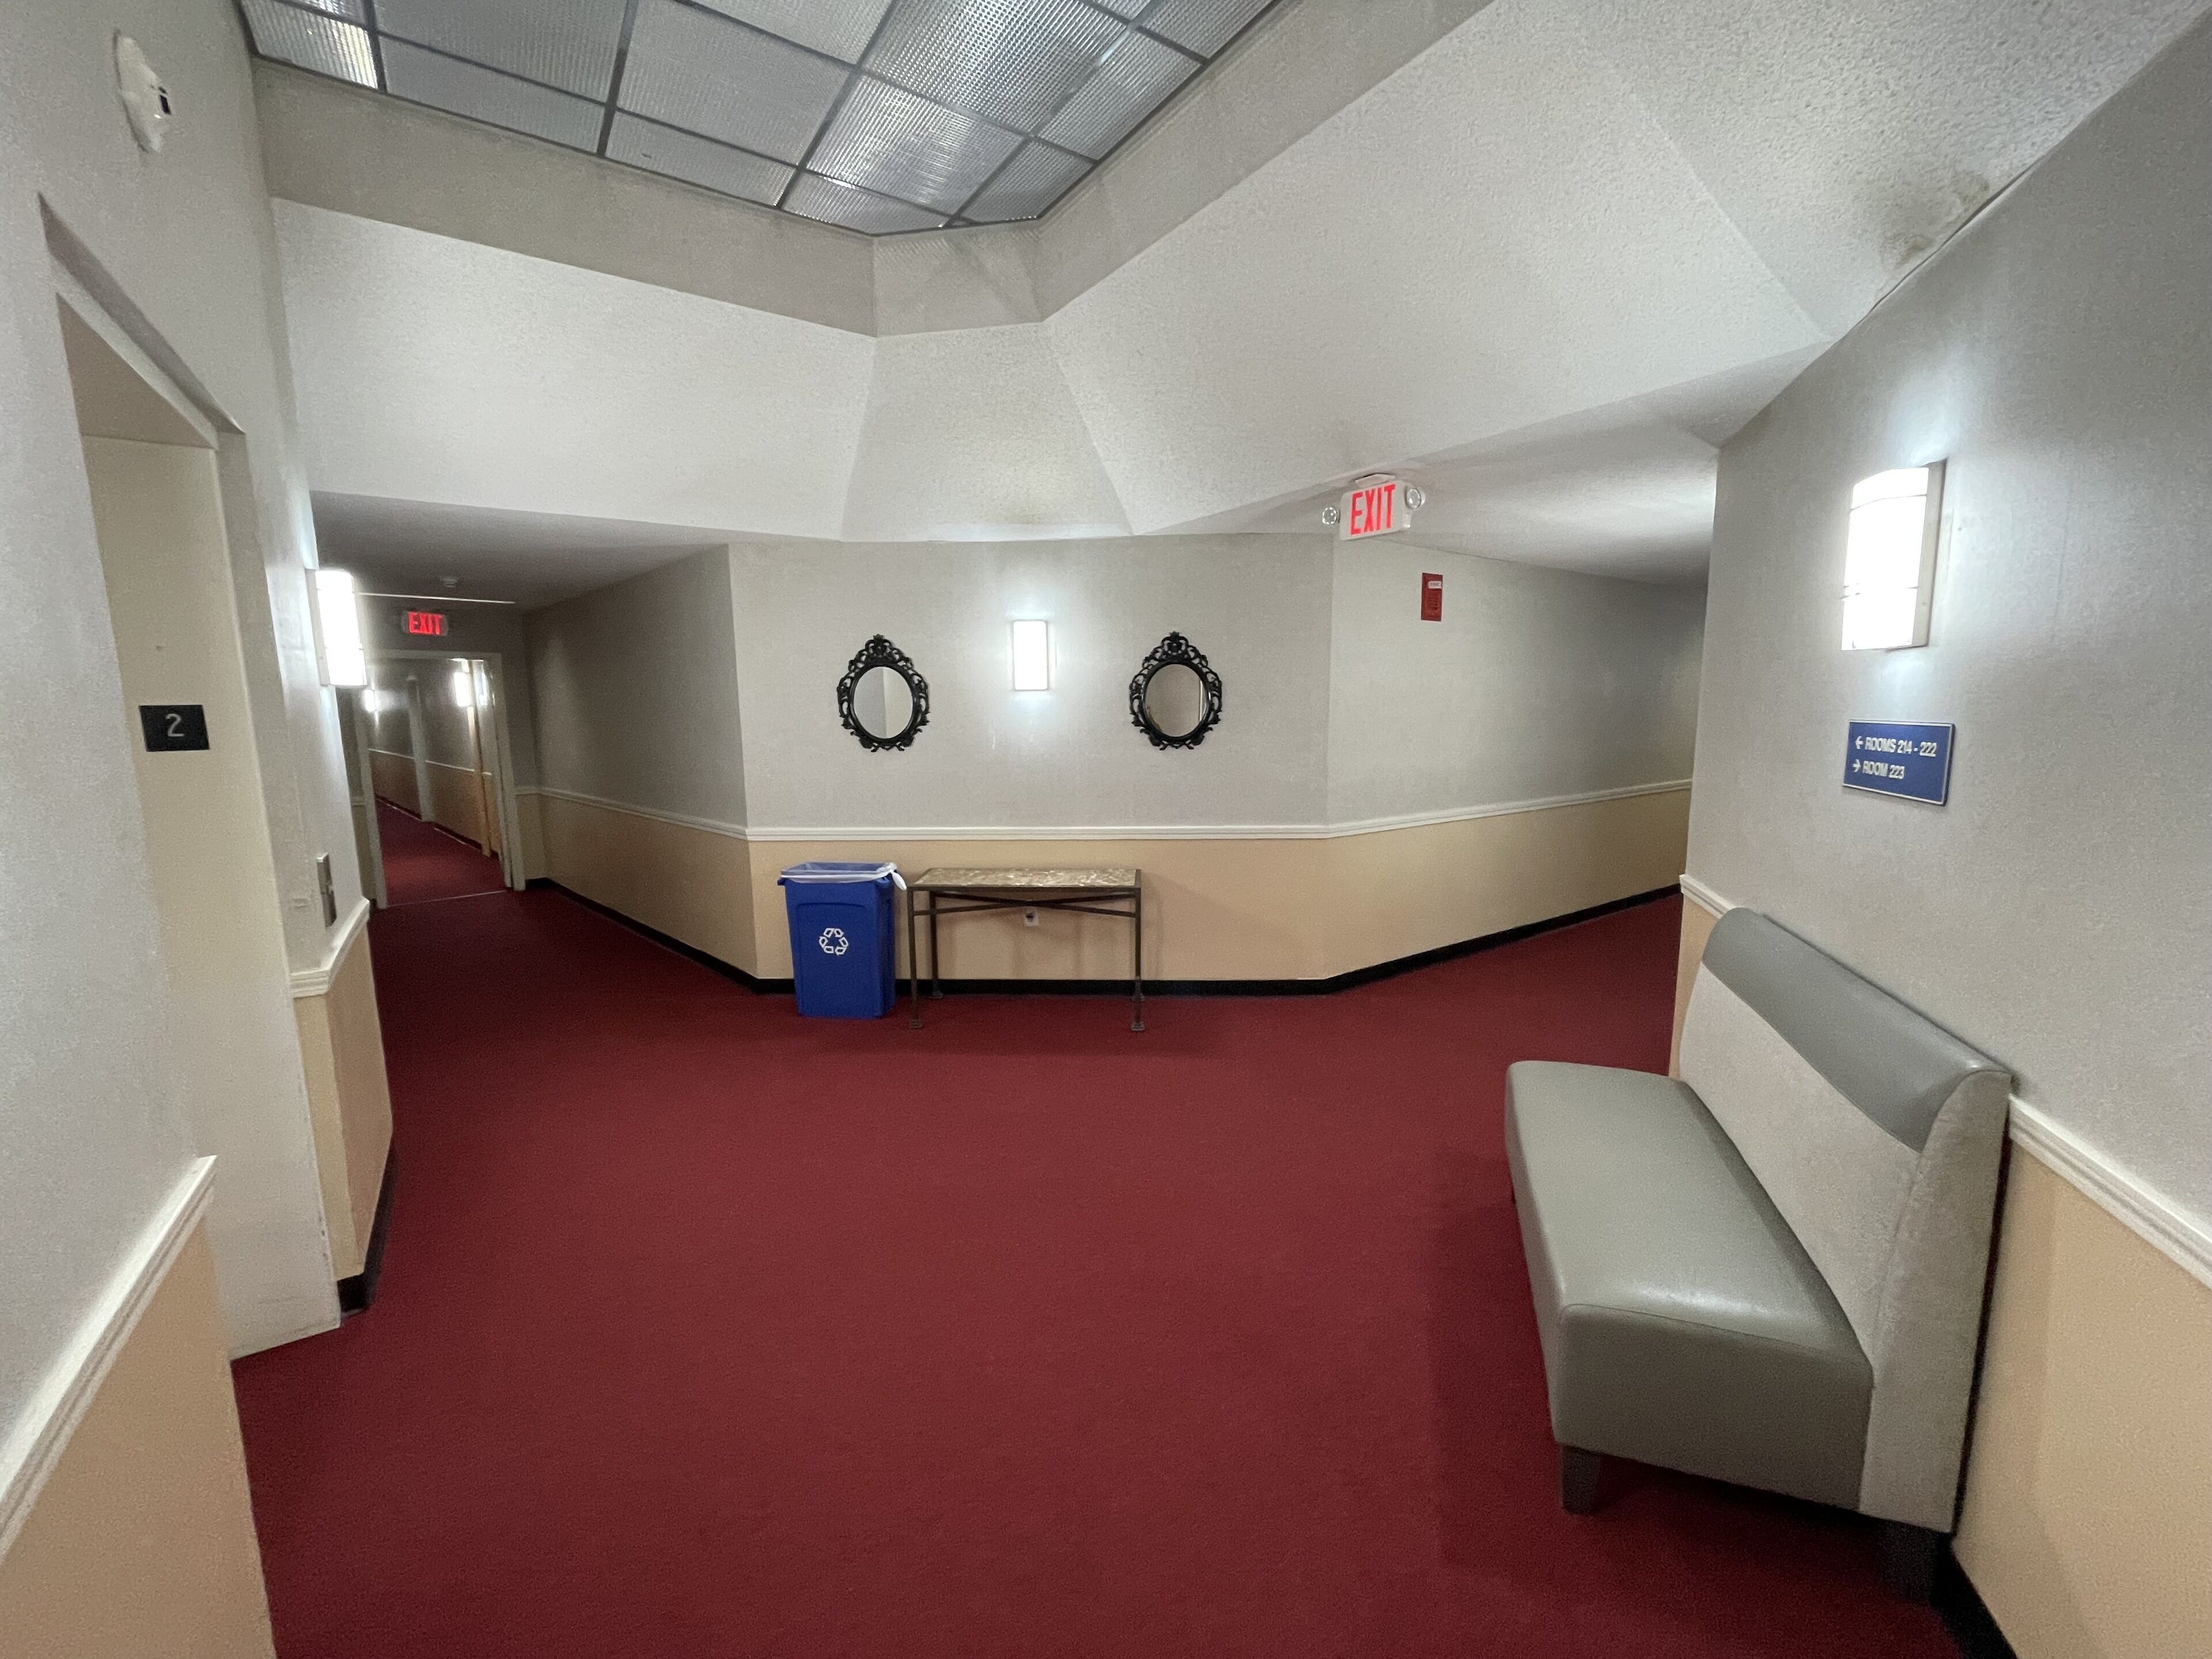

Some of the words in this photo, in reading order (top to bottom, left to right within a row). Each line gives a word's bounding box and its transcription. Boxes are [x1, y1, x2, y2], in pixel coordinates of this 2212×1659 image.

[1350, 484, 1396, 536] EXIT
[408, 612, 442, 635] EXIT
[165, 713, 184, 737] 2
[1865, 737, 1896, 753] ROOMS
[1897, 740, 1912, 755] 214
[1919, 742, 1937, 757] 222
[1862, 760, 1888, 777] ROOM
[1889, 765, 1905, 779] 223
